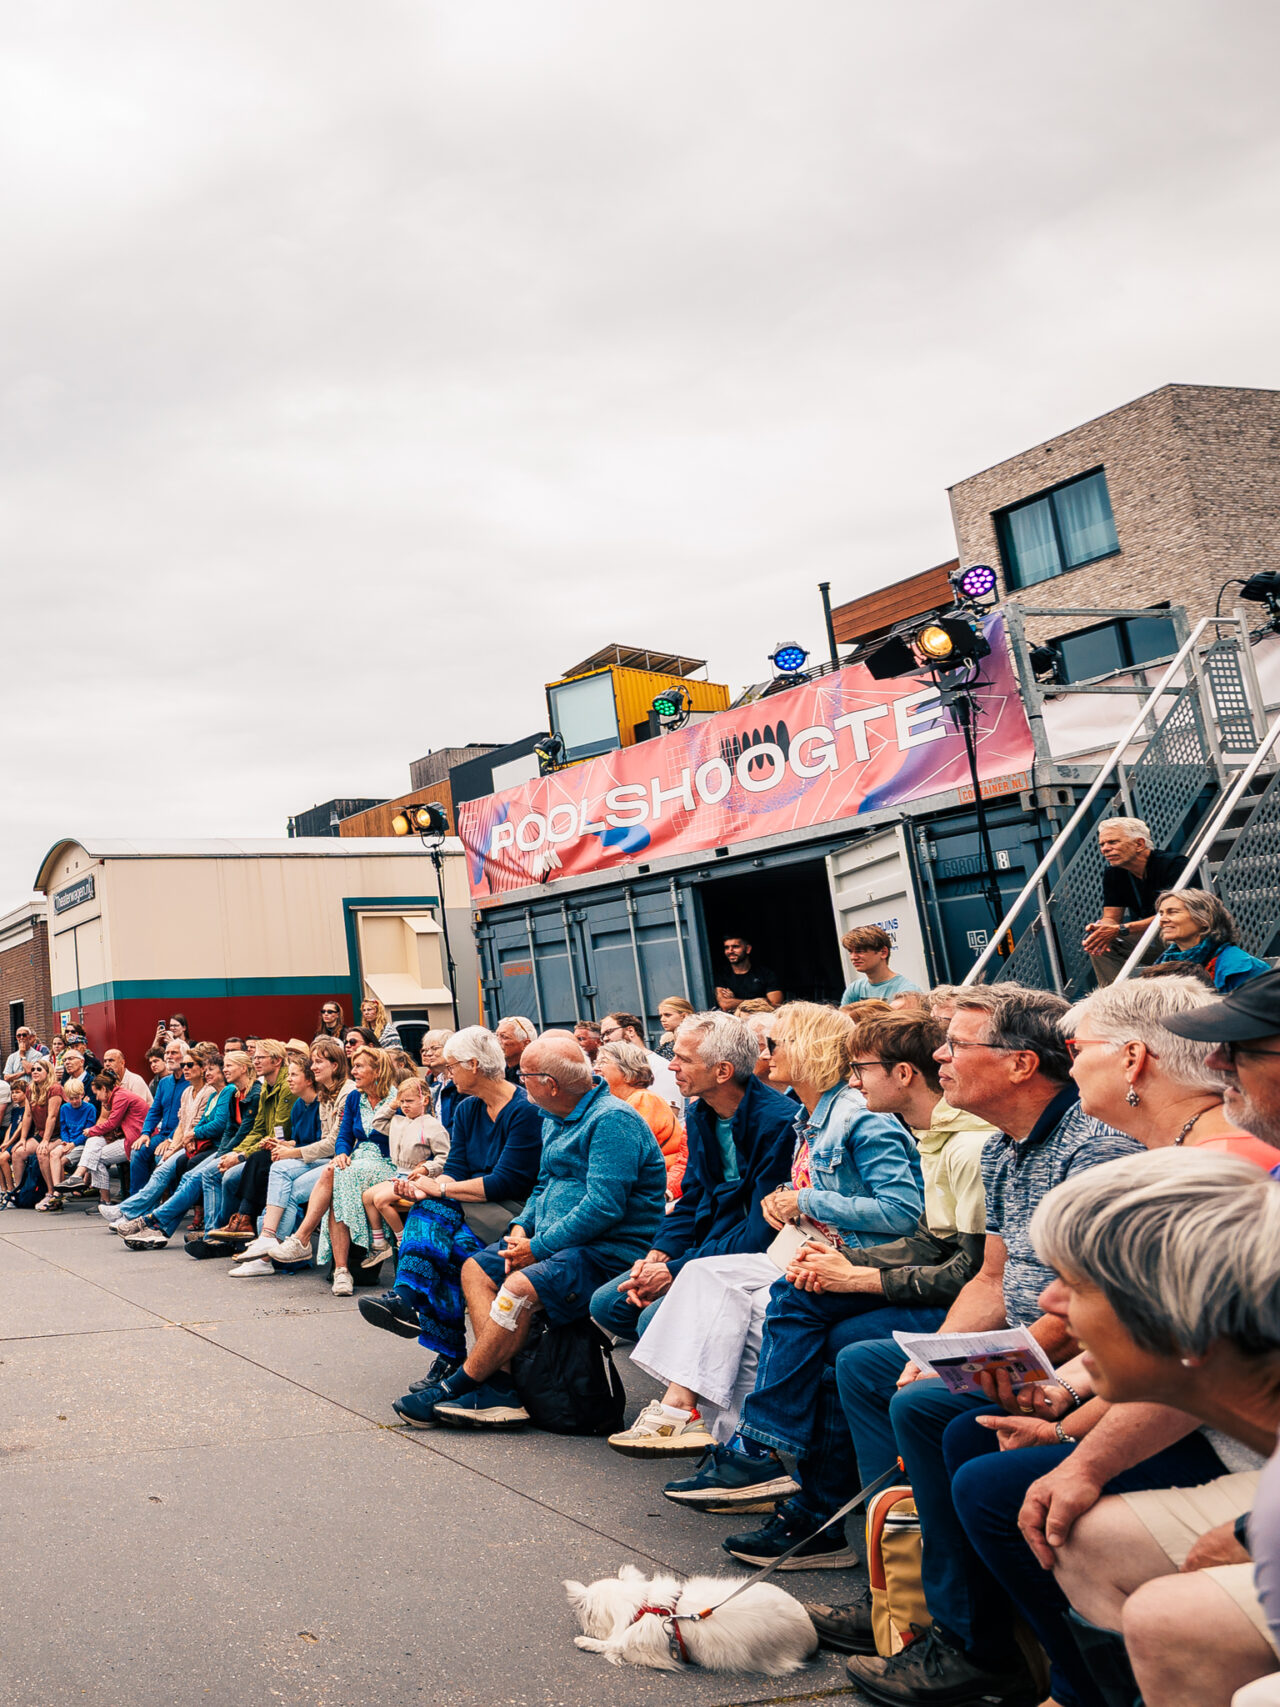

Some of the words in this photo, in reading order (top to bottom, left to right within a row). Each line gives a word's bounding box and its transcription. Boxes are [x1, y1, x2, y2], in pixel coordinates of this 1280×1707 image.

[489, 686, 948, 861] POOLSHOOGTE
[962, 778, 1024, 800] COTAINER.NL
[998, 852, 1008, 869] 8
